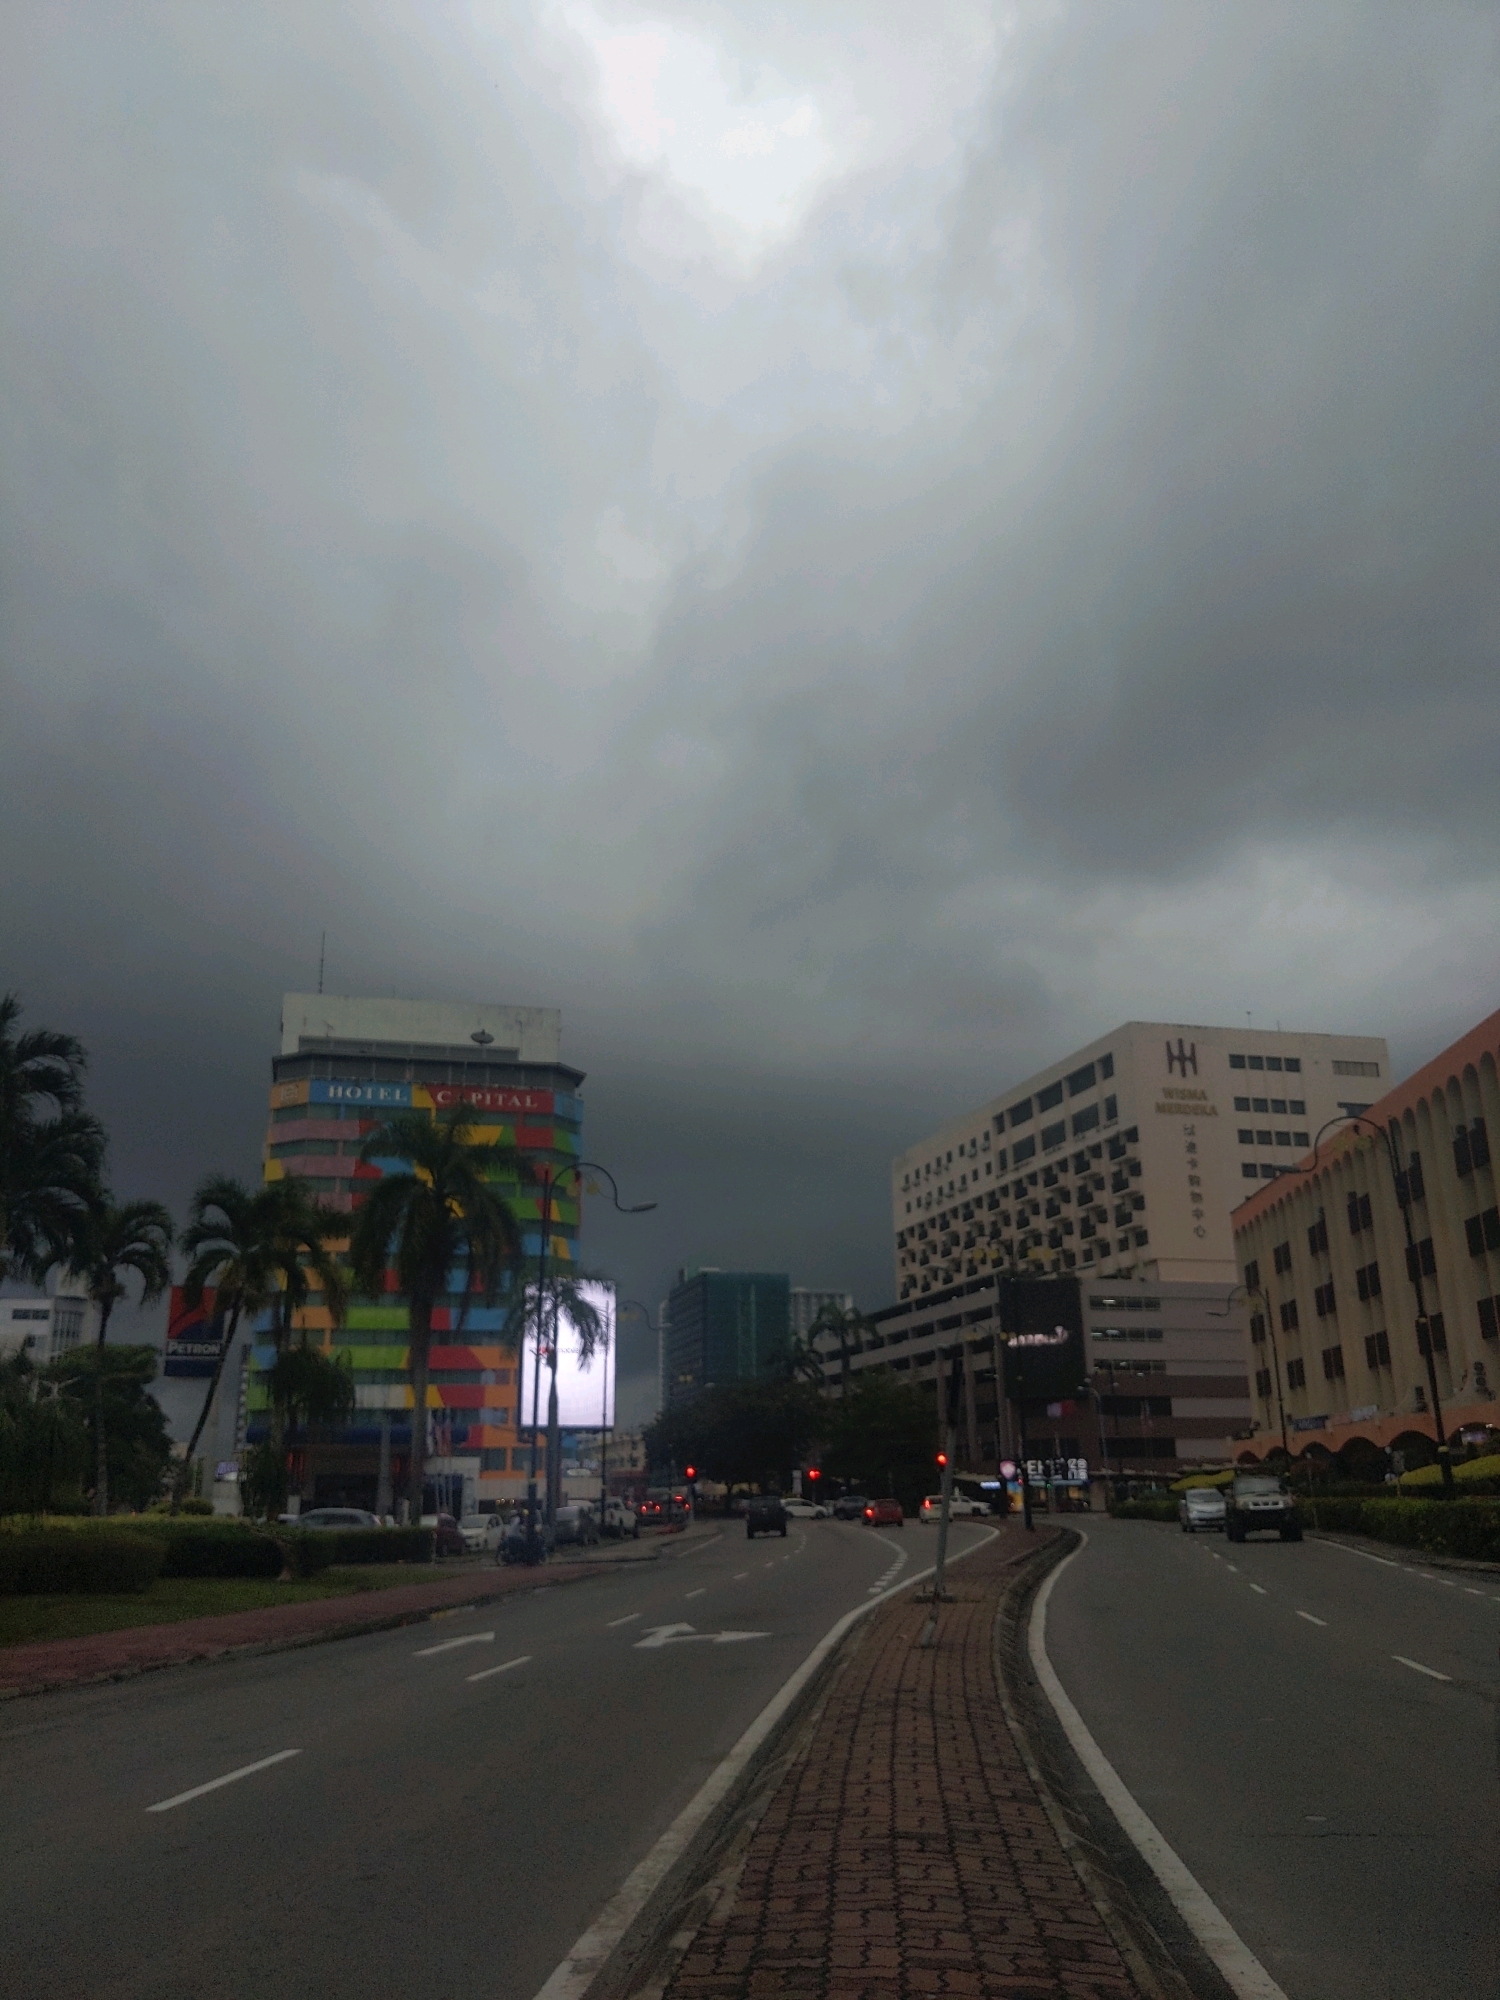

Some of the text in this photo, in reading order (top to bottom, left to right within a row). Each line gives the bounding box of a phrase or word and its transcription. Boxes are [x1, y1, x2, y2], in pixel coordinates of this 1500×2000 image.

[328, 1085, 407, 1101] HOTEL
[1162, 1087, 1208, 1101] WISMA
[1155, 1102, 1218, 1116] MERDEKA
[168, 1341, 221, 1355] PETRON
